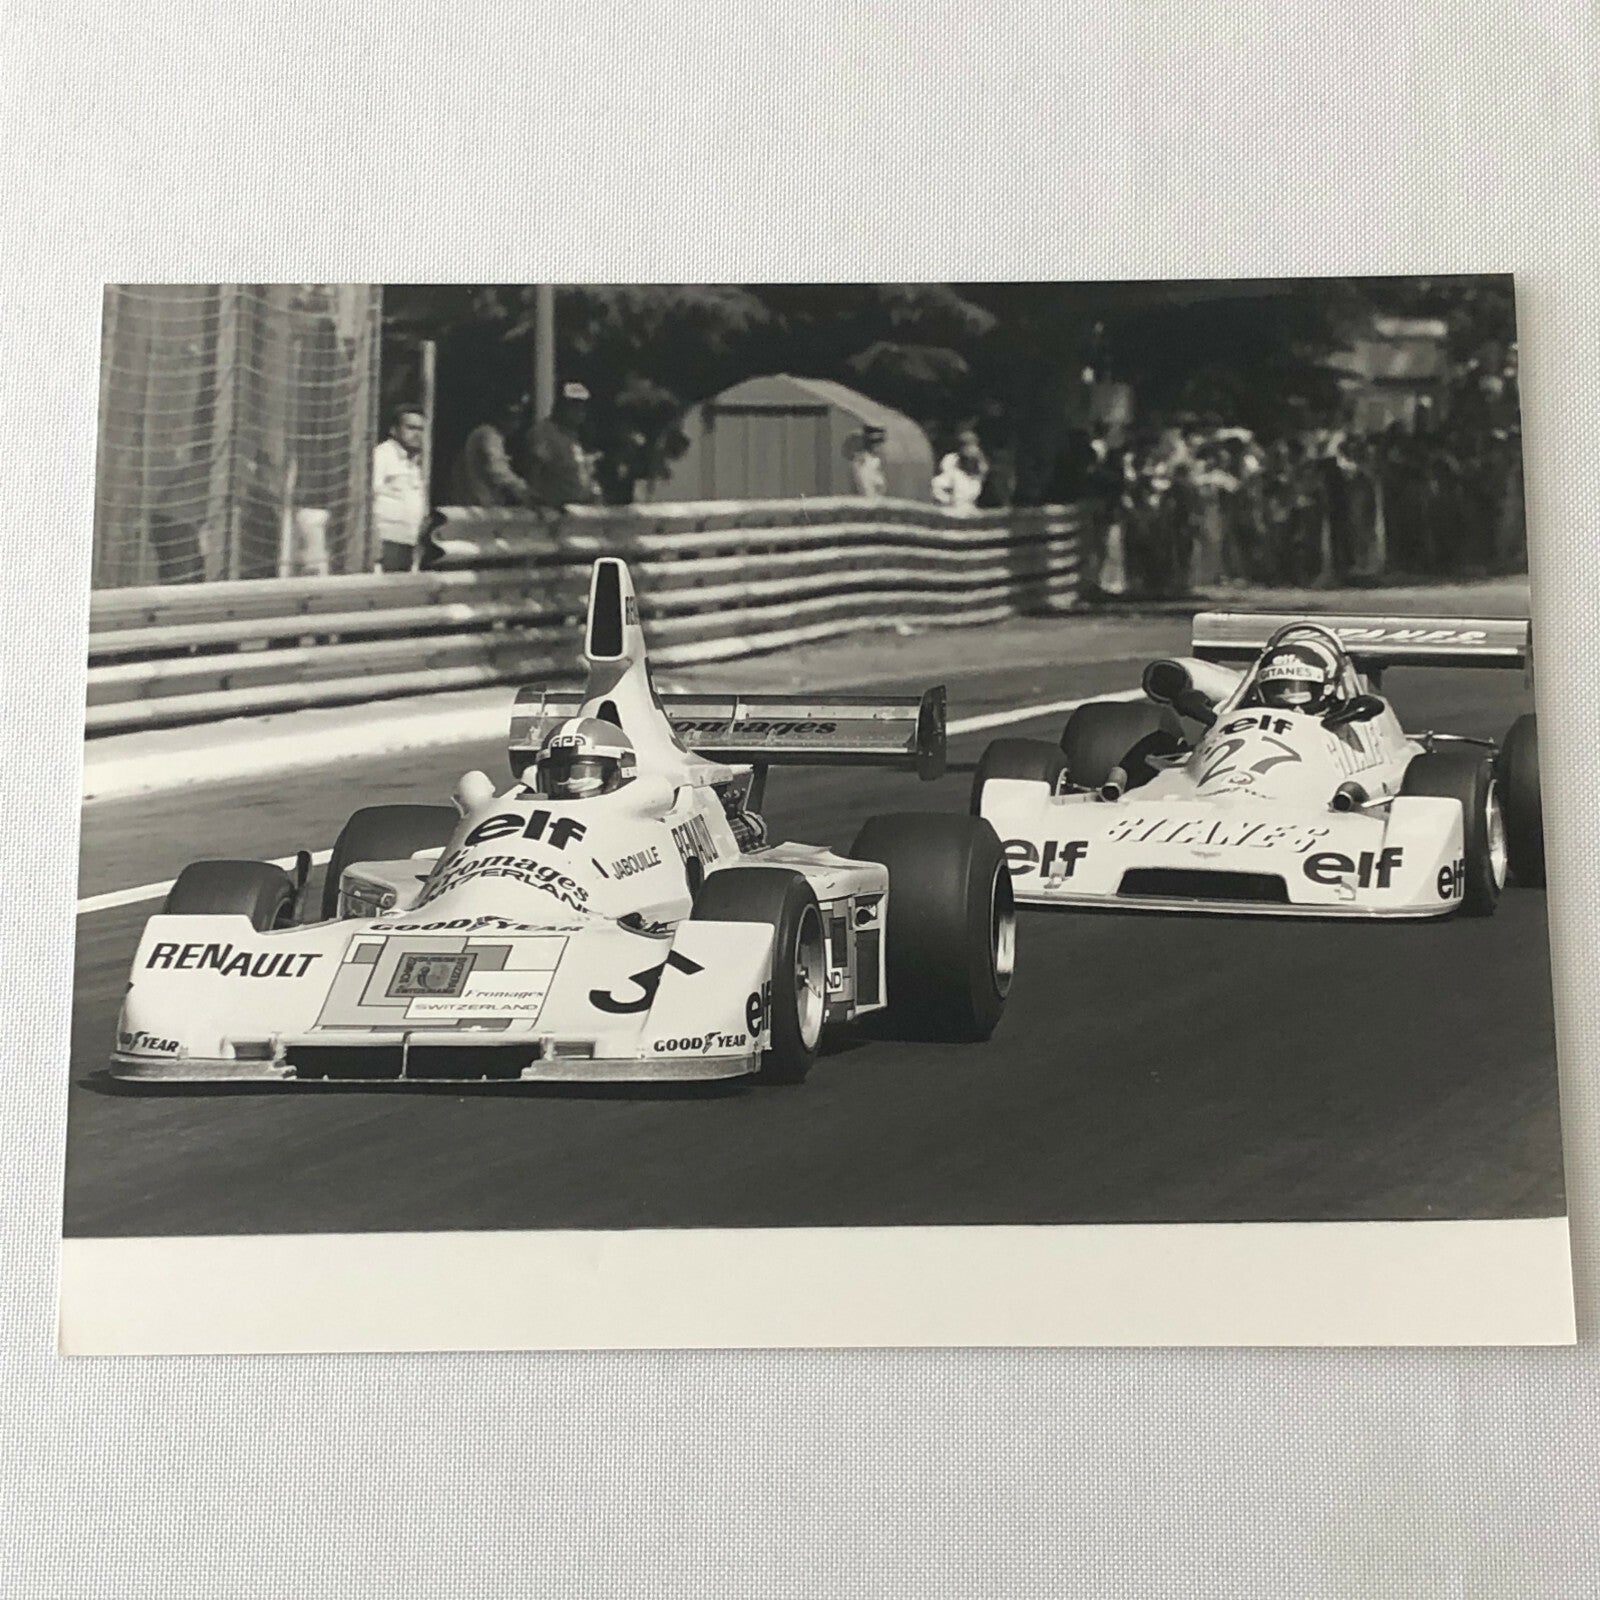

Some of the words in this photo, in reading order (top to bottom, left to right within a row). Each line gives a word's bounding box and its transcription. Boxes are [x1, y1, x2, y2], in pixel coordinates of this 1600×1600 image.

[672, 721, 837, 736] omages
[1218, 714, 1294, 735] elf
[1196, 735, 1302, 788] 27
[464, 809, 588, 850] elf
[611, 846, 662, 880] JABOUILLE
[1001, 838, 1089, 878] elf
[1302, 846, 1404, 889] elf
[369, 918, 472, 931] GOOD
[145, 942, 323, 978] RENAULT
[464, 989, 544, 998] Fromages
[588, 948, 706, 1014] 3
[415, 1003, 538, 1011] SWITZERLAND
[141, 1036, 180, 1053] YEAR
[653, 1037, 703, 1053] GOOD
[717, 1034, 747, 1048] YEAR
